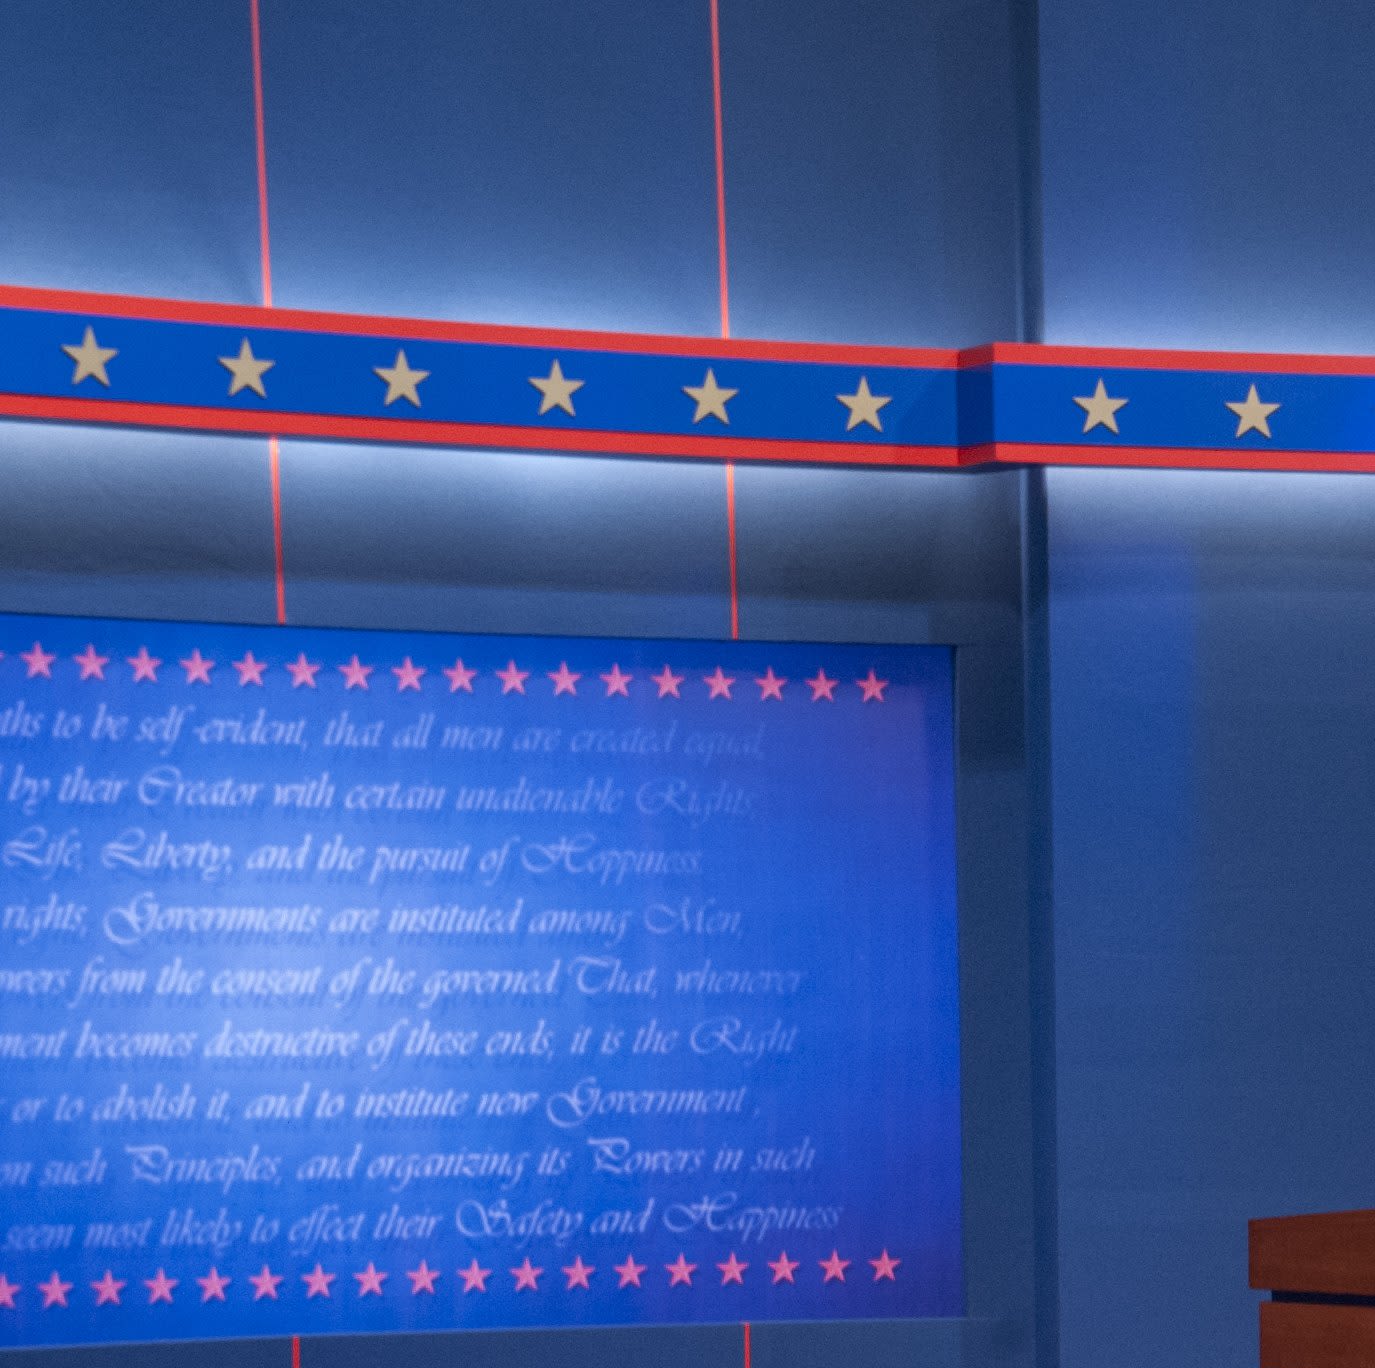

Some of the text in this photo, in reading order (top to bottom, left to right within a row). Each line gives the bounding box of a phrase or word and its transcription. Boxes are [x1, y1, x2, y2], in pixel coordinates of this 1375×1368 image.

[52, 707, 82, 739] to
[90, 703, 129, 740] be
[323, 711, 384, 748] that
[392, 713, 435, 749] all
[441, 722, 501, 751] men
[513, 725, 562, 752] are
[571, 719, 677, 754] created
[8, 764, 51, 816] by
[58, 765, 129, 802] their
[137, 764, 262, 807] Creator
[273, 771, 334, 808] with
[344, 782, 446, 810] certain
[246, 834, 312, 872] and
[318, 834, 366, 871] the
[369, 843, 469, 885] pursuit
[479, 836, 521, 886] of
[103, 891, 322, 945] Governments
[329, 907, 380, 933] are
[388, 899, 523, 934] instituted
[528, 908, 633, 946] among
[69, 956, 147, 1009] from
[156, 956, 204, 995] the
[211, 966, 322, 995] consent
[330, 957, 373, 1009] of
[369, 957, 415, 994] the
[423, 958, 561, 1010] governed
[675, 959, 808, 994] whenever
[75, 1021, 197, 1059] becomes
[204, 1021, 360, 1058] destructive
[366, 1018, 409, 1070] of
[405, 1019, 479, 1057] these
[570, 1024, 590, 1054] it
[602, 1026, 623, 1055] is
[632, 1019, 679, 1055] the
[12, 1096, 48, 1122] or
[54, 1093, 84, 1122] to
[92, 1083, 197, 1122] abolish
[244, 1082, 312, 1118] and
[315, 1089, 345, 1118] to
[354, 1086, 469, 1117] institute
[477, 1088, 540, 1115] new
[41, 1148, 107, 1186] such
[296, 1143, 364, 1180] and
[367, 1147, 532, 1192] organizing
[538, 1145, 572, 1176] its
[587, 1136, 706, 1175] Powers
[713, 1143, 745, 1171] in
[751, 1136, 817, 1172] such
[84, 1218, 153, 1247] most
[161, 1207, 243, 1256] likely
[250, 1211, 279, 1243] to
[288, 1203, 366, 1256] effect
[373, 1205, 443, 1241] their
[454, 1199, 584, 1250] Safety
[590, 1197, 654, 1234] and
[662, 1191, 845, 1243] Happiness
